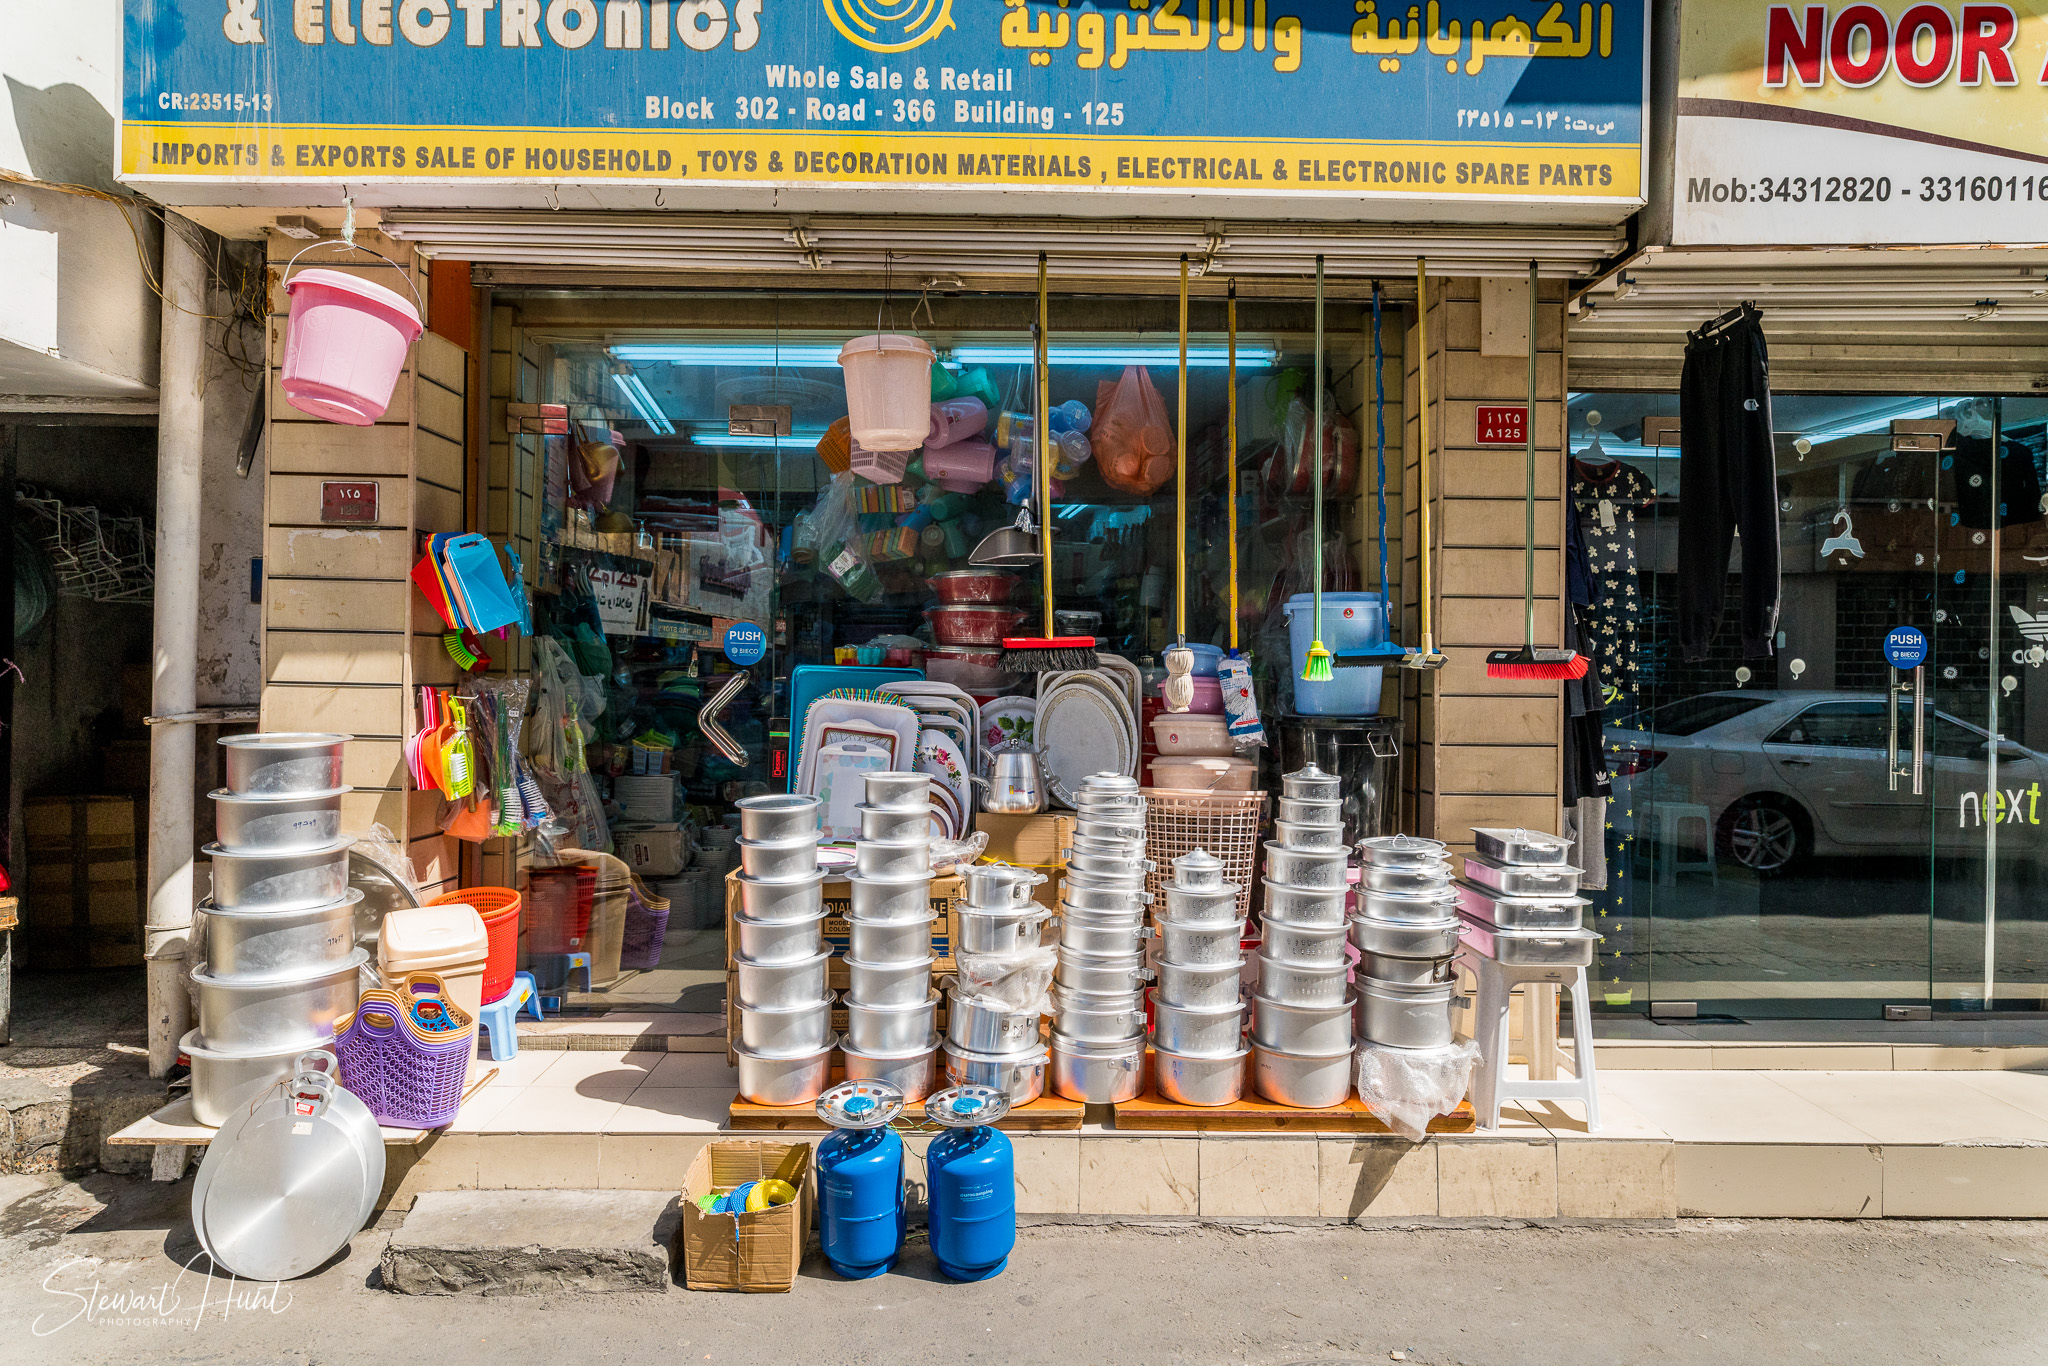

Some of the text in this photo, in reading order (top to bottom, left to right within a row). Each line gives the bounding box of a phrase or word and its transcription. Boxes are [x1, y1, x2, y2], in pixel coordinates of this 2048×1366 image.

[222, 0, 266, 45] &
[1763, 2, 2019, 89] NOOR
[765, 65, 1011, 92] Whole Sale & Retail
[158, 93, 273, 112] CR:23515-13
[646, 96, 714, 120] Block
[735, 97, 778, 121] 302
[806, 98, 865, 123] Road
[892, 100, 936, 124] 366
[953, 101, 1053, 131] Building
[1080, 104, 1123, 128] 125
[152, 142, 260, 167] IMPORTS
[271, 146, 285, 168] &
[296, 145, 406, 170] EXPORTS
[416, 146, 476, 170] SALE
[485, 148, 516, 171] OF
[525, 148, 672, 173] HOUSEHOLD
[697, 150, 759, 174] TOYS
[768, 151, 784, 174] &
[793, 151, 948, 177] DECORATION
[956, 153, 1091, 178] MATERIALS
[1116, 156, 1264, 181] ELECTRICAL
[1275, 159, 1290, 181] &
[1299, 159, 1447, 184] ELECTRONIC
[1455, 162, 1529, 186] SPARE
[1538, 163, 1612, 187] PARTS
[1687, 177, 1893, 203] Mob:34312820
[1919, 176, 2048, 203] 33160116
[1485, 428, 1521, 439] A 125
[340, 489, 361, 499] ١٢٥
[729, 631, 761, 641] PUSH
[1890, 634, 1922, 645] PUSH
[1959, 782, 2042, 828] next
